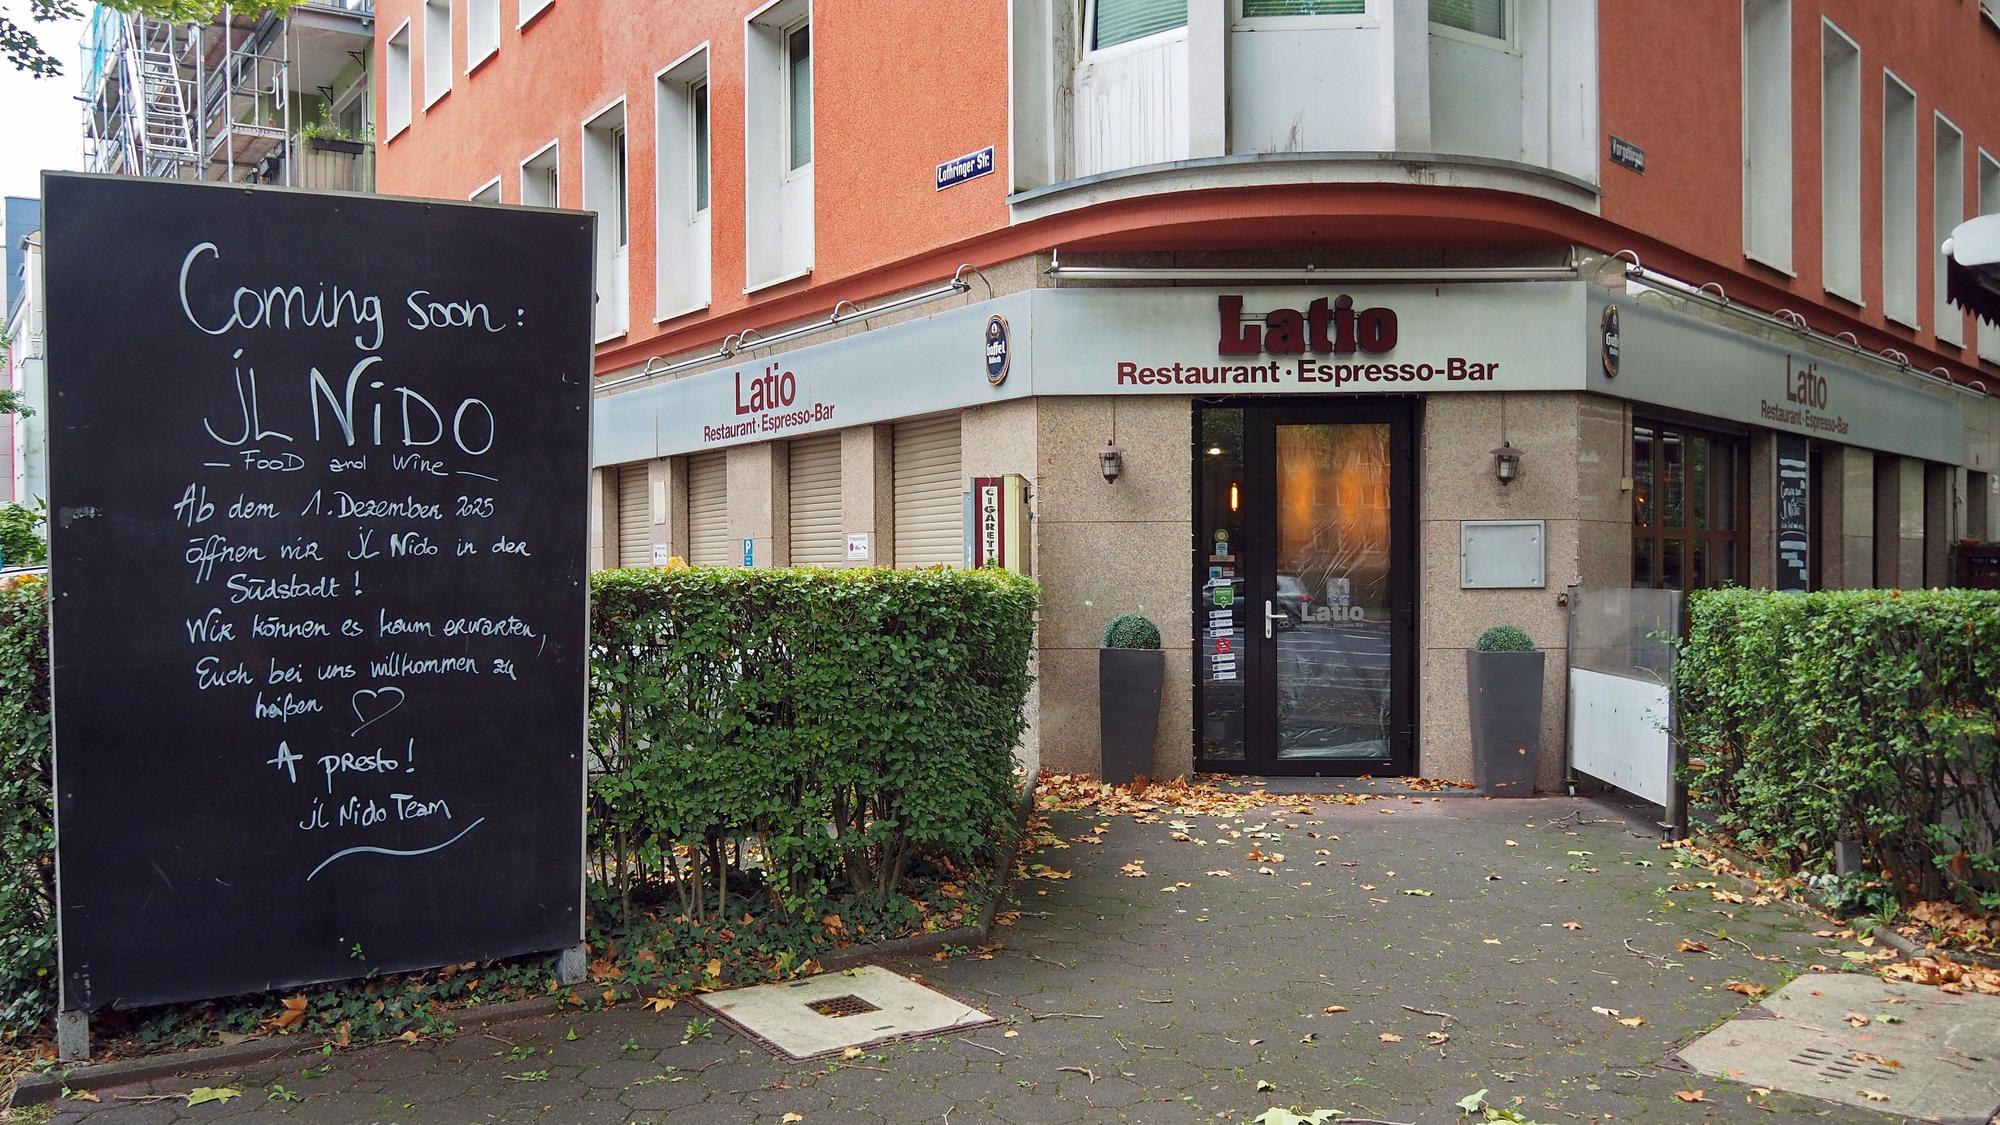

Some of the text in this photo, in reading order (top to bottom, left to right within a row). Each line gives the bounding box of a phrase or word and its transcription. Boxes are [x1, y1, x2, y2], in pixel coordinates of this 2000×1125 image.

[938, 151, 990, 183] Lothringer Str.
[179, 242, 384, 351] Coming
[1218, 294, 1398, 356] Latio
[735, 362, 796, 416] Latio
[1117, 357, 1499, 387] Restaurant Espresso-Bar
[1786, 354, 1827, 410] Latio
[704, 402, 835, 442] Restaurant Espresso-Bar
[1761, 399, 1849, 435] Restaurant Espresso-Bar
[329, 454, 367, 473] and
[392, 453, 449, 476] Wine
[173, 482, 215, 527] Ab
[228, 493, 281, 519] dem
[455, 495, 494, 518] 2025
[391, 531, 439, 557] Nido
[456, 539, 478, 557] in
[491, 535, 531, 557] der
[745, 540, 752, 554] P
[252, 613, 331, 639] können
[341, 618, 364, 637] es
[379, 607, 435, 638] kaum
[1301, 602, 1364, 621] Latio
[195, 651, 517, 690] Euch bei uns willkommen zu
[255, 691, 324, 723] heißen
[266, 740, 304, 784] A
[339, 795, 387, 827] Nido
[390, 793, 452, 821] Team
